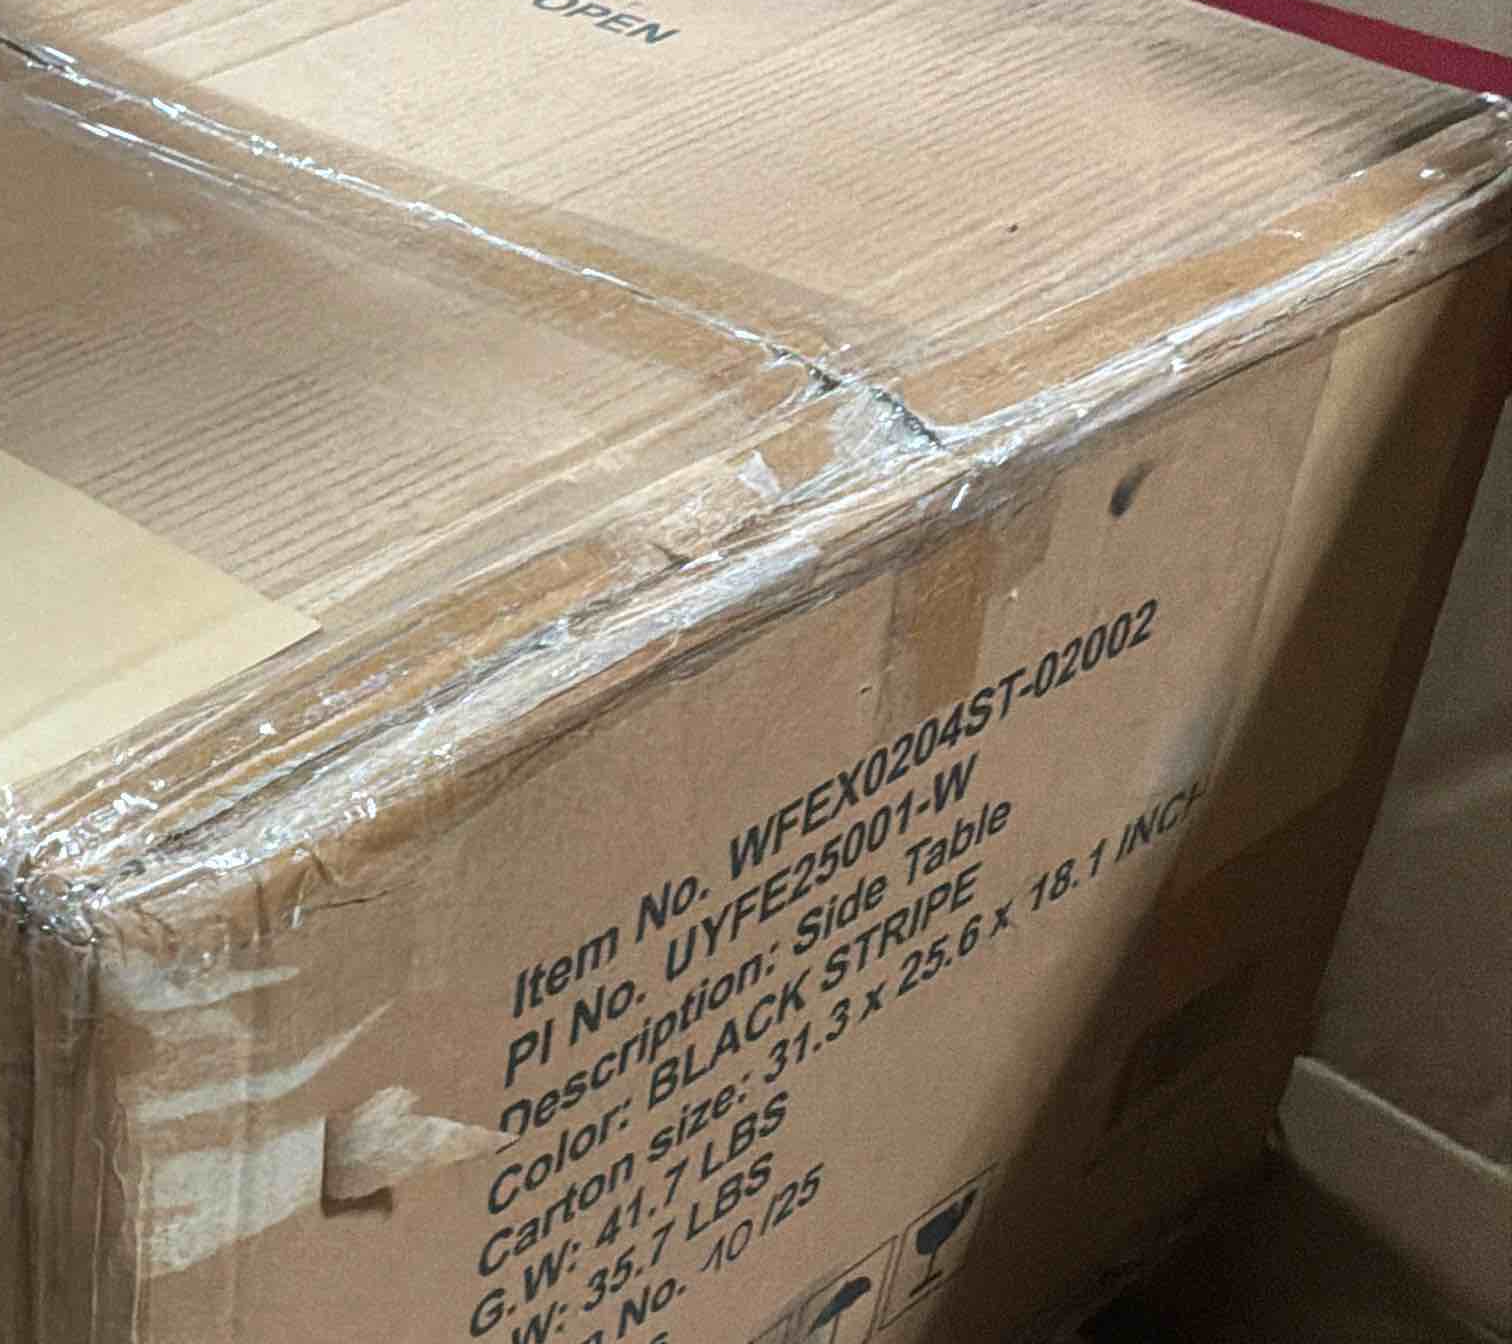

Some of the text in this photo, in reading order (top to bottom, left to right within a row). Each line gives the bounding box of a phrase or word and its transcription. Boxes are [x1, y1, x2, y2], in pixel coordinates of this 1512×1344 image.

[503, 752, 979, 1089] PI No. UYFE25001-W
[511, 598, 1160, 1019] Item No. WFEX0204ST-02002
[792, 874, 889, 955] Side
[905, 801, 1013, 886] Table
[477, 1150, 635, 1277] Carton
[646, 1070, 753, 1164] size:
[762, 996, 851, 1084] 31.3
[857, 979, 889, 1024] x
[895, 912, 984, 998] 25.6
[990, 896, 1015, 938] x
[1028, 837, 1108, 912] 18.1
[487, 861, 983, 1215] Color: BLACK STRIPE
[582, 1217, 677, 1312] 35.7
[684, 1151, 775, 1242] LBS
[594, 1156, 690, 1249] 41.7
[699, 1090, 789, 1183] LBS
[616, 1276, 687, 1340] No.
